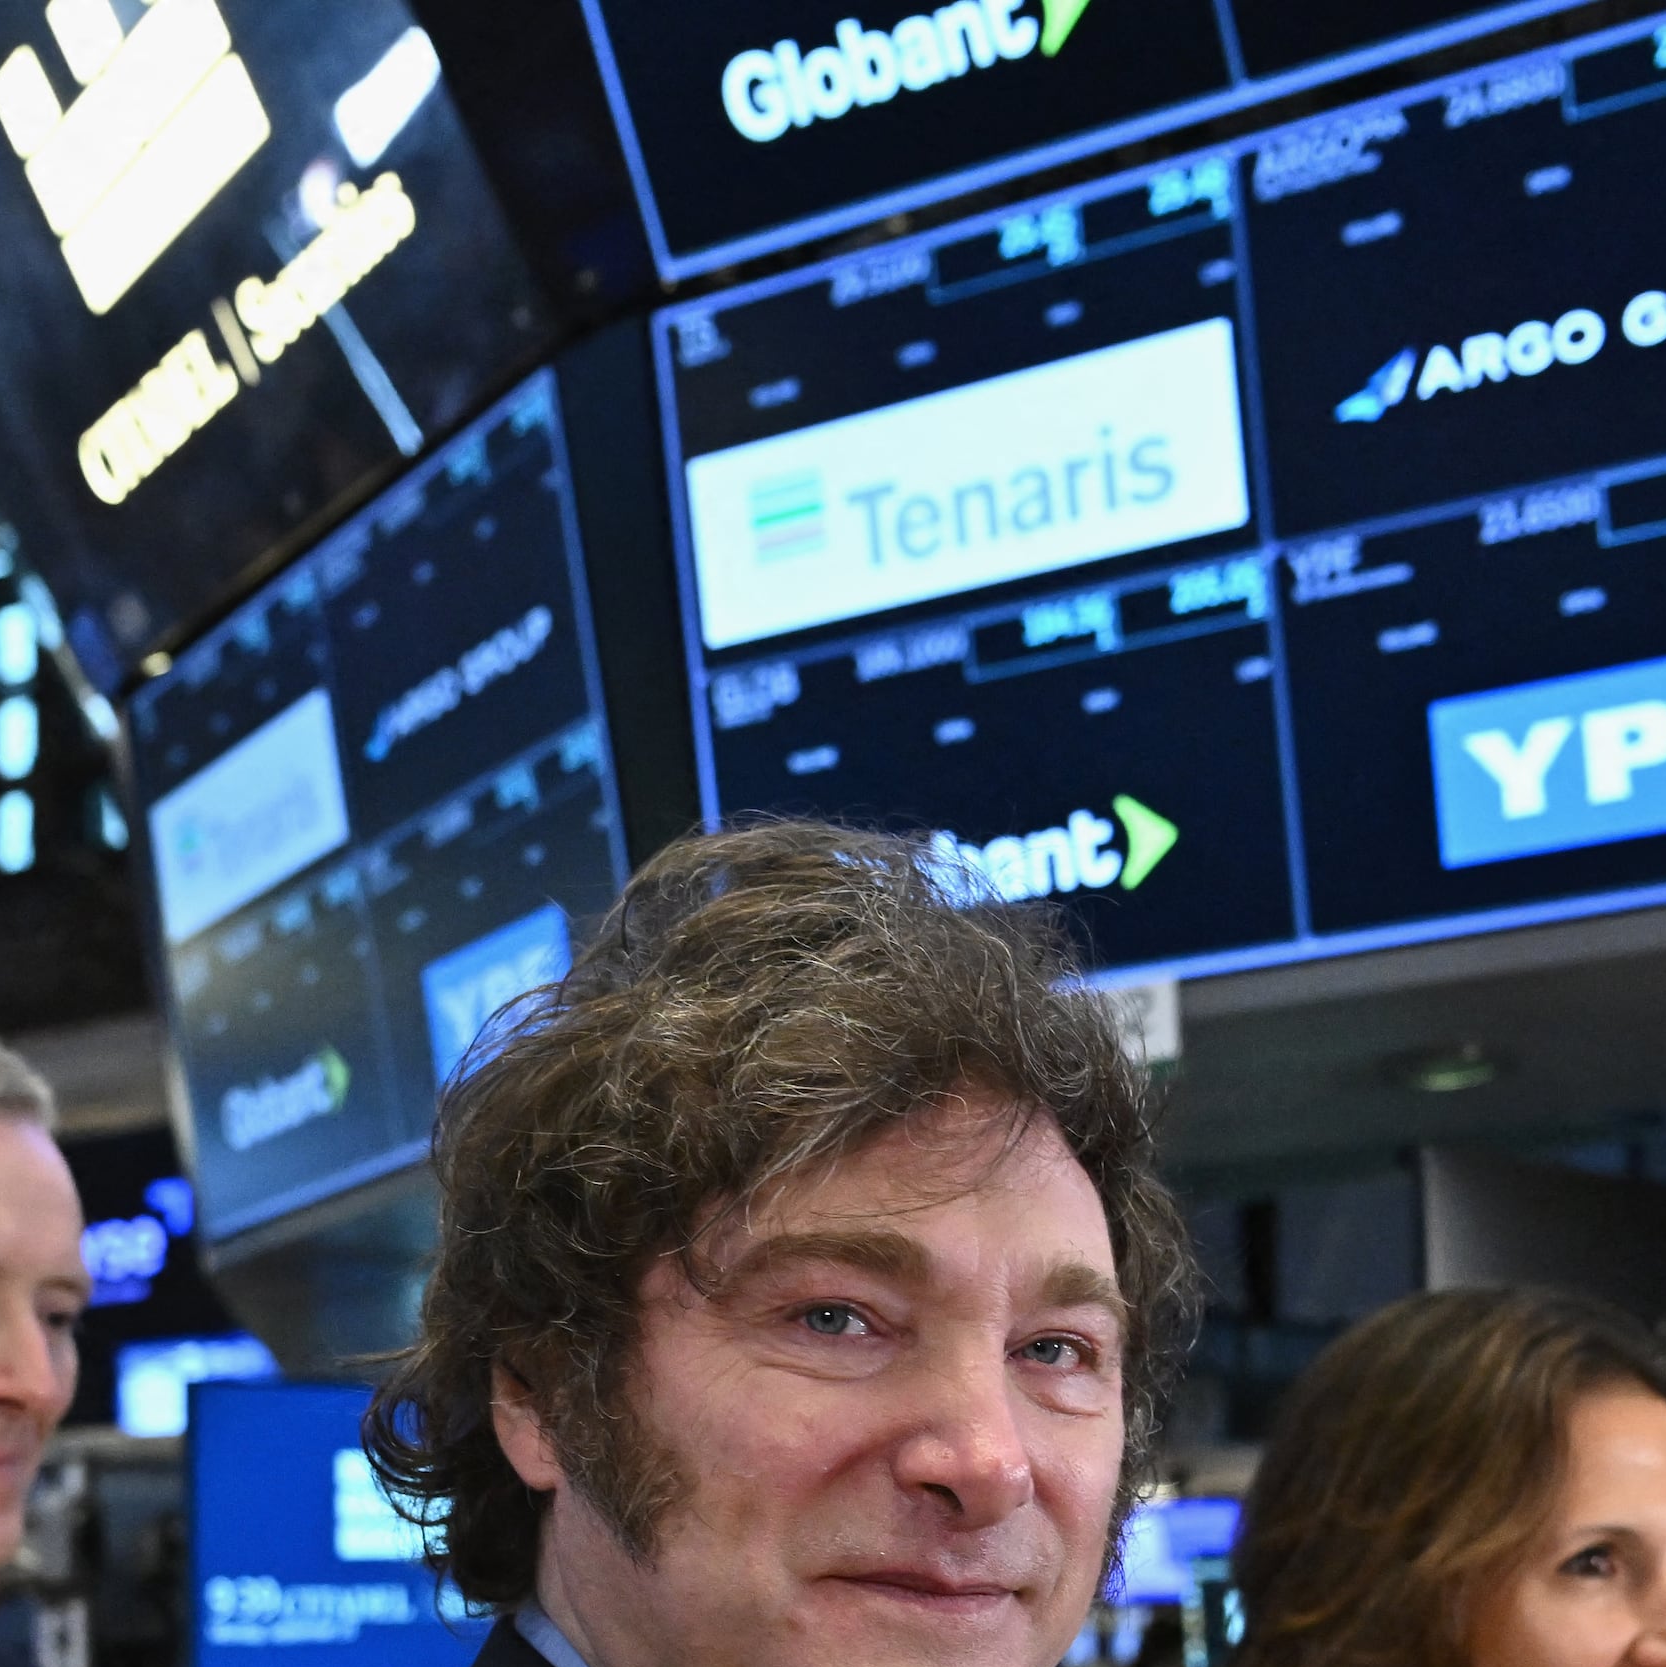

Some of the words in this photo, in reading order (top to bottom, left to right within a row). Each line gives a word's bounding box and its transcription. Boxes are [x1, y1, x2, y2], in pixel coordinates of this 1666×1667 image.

[722, 0, 1039, 142] Globant
[1416, 308, 1606, 400] ARGO
[844, 424, 1177, 568] Tenaris
[913, 807, 1123, 911] bant
